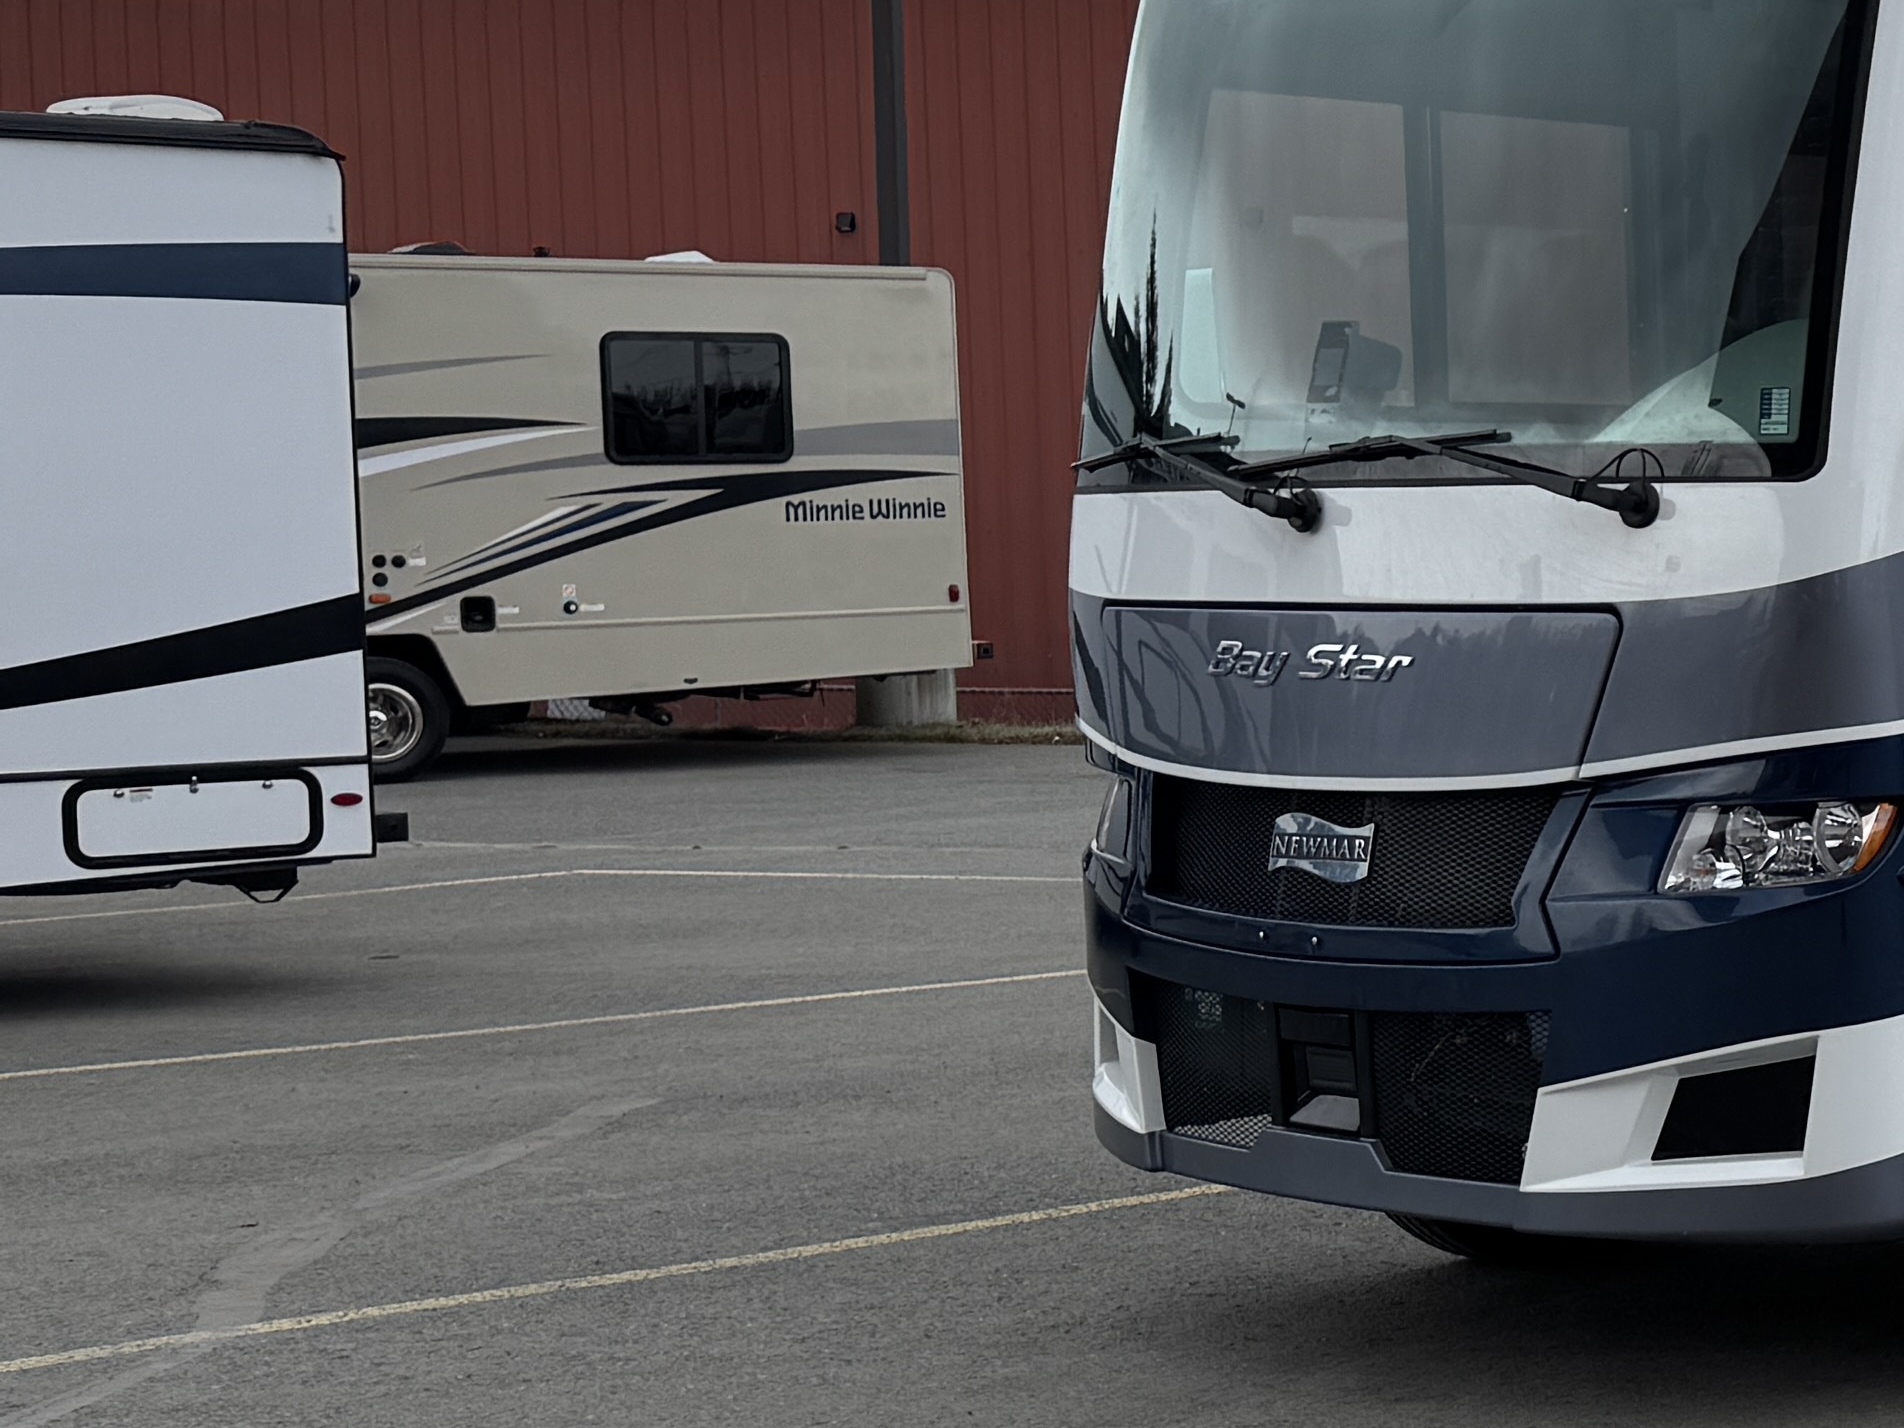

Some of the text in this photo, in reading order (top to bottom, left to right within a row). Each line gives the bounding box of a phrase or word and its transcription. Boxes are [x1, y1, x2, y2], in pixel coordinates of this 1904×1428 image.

[784, 496, 947, 523] Minnie Winnie
[1207, 639, 1416, 688] Bay Star
[1272, 834, 1367, 860] NEWMAR
